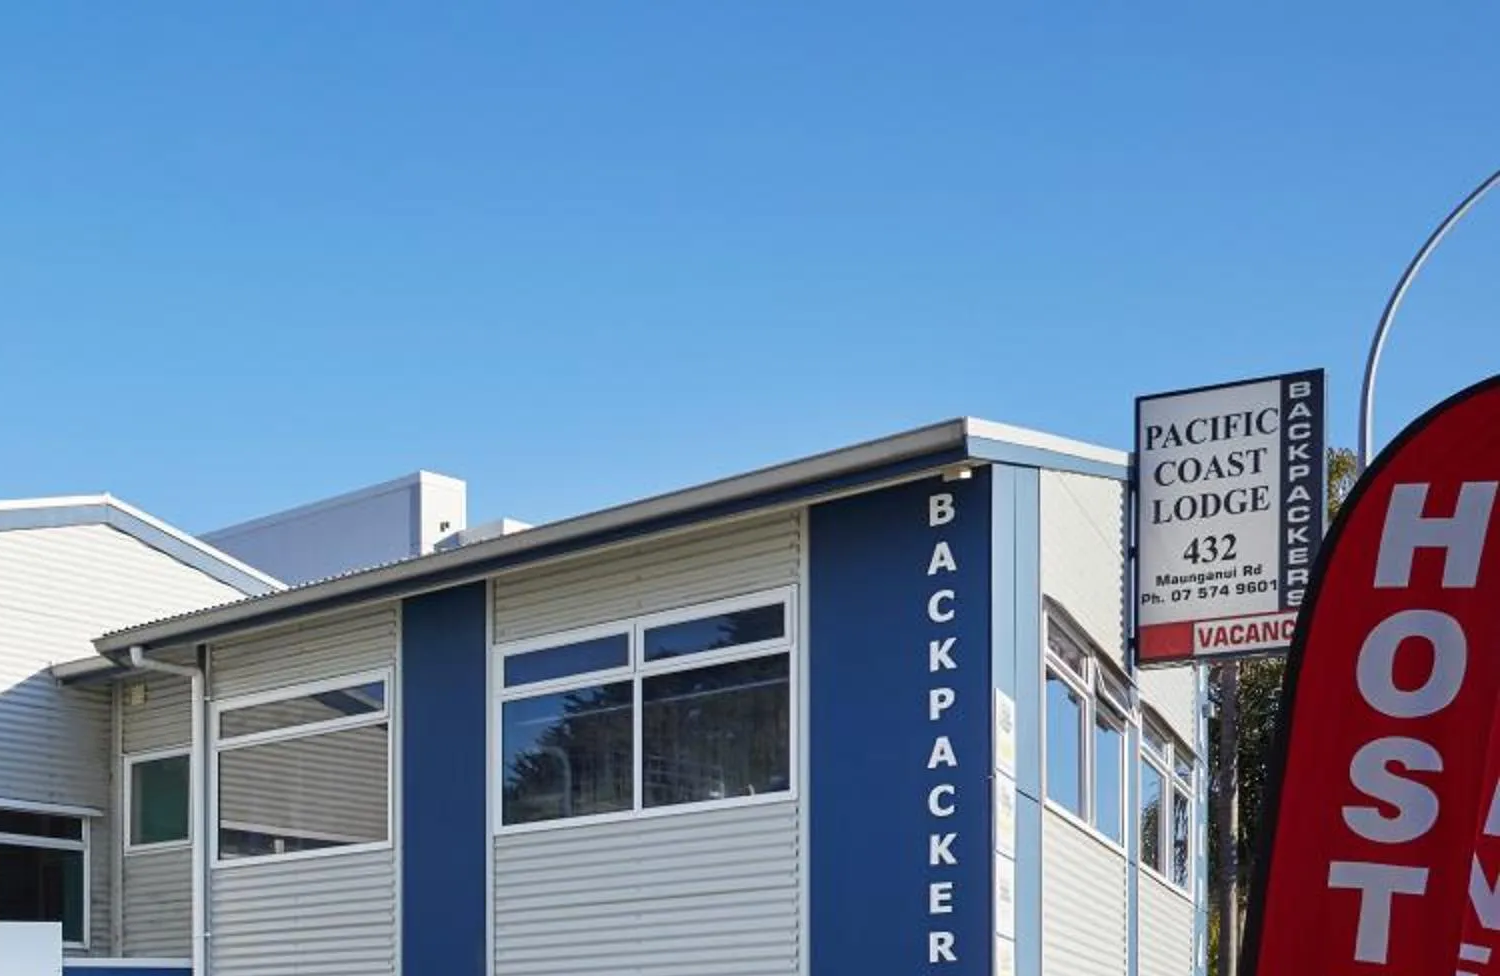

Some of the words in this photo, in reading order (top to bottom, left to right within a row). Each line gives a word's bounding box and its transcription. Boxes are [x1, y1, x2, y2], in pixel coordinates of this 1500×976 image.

[1145, 407, 1279, 450] PACIFIC
[1154, 447, 1268, 487] COAST
[1151, 485, 1271, 525] LODGE
[1288, 381, 1313, 607] BACKPACKERS
[1183, 533, 1237, 565] 432
[1141, 592, 1165, 605] Ph.
[1171, 588, 1192, 602] 07
[1197, 584, 1229, 600] 574
[1235, 579, 1278, 595] 9601
[1155, 567, 1237, 587] Maunganui
[1243, 564, 1263, 577] Rd
[1198, 618, 1298, 649] VACANC
